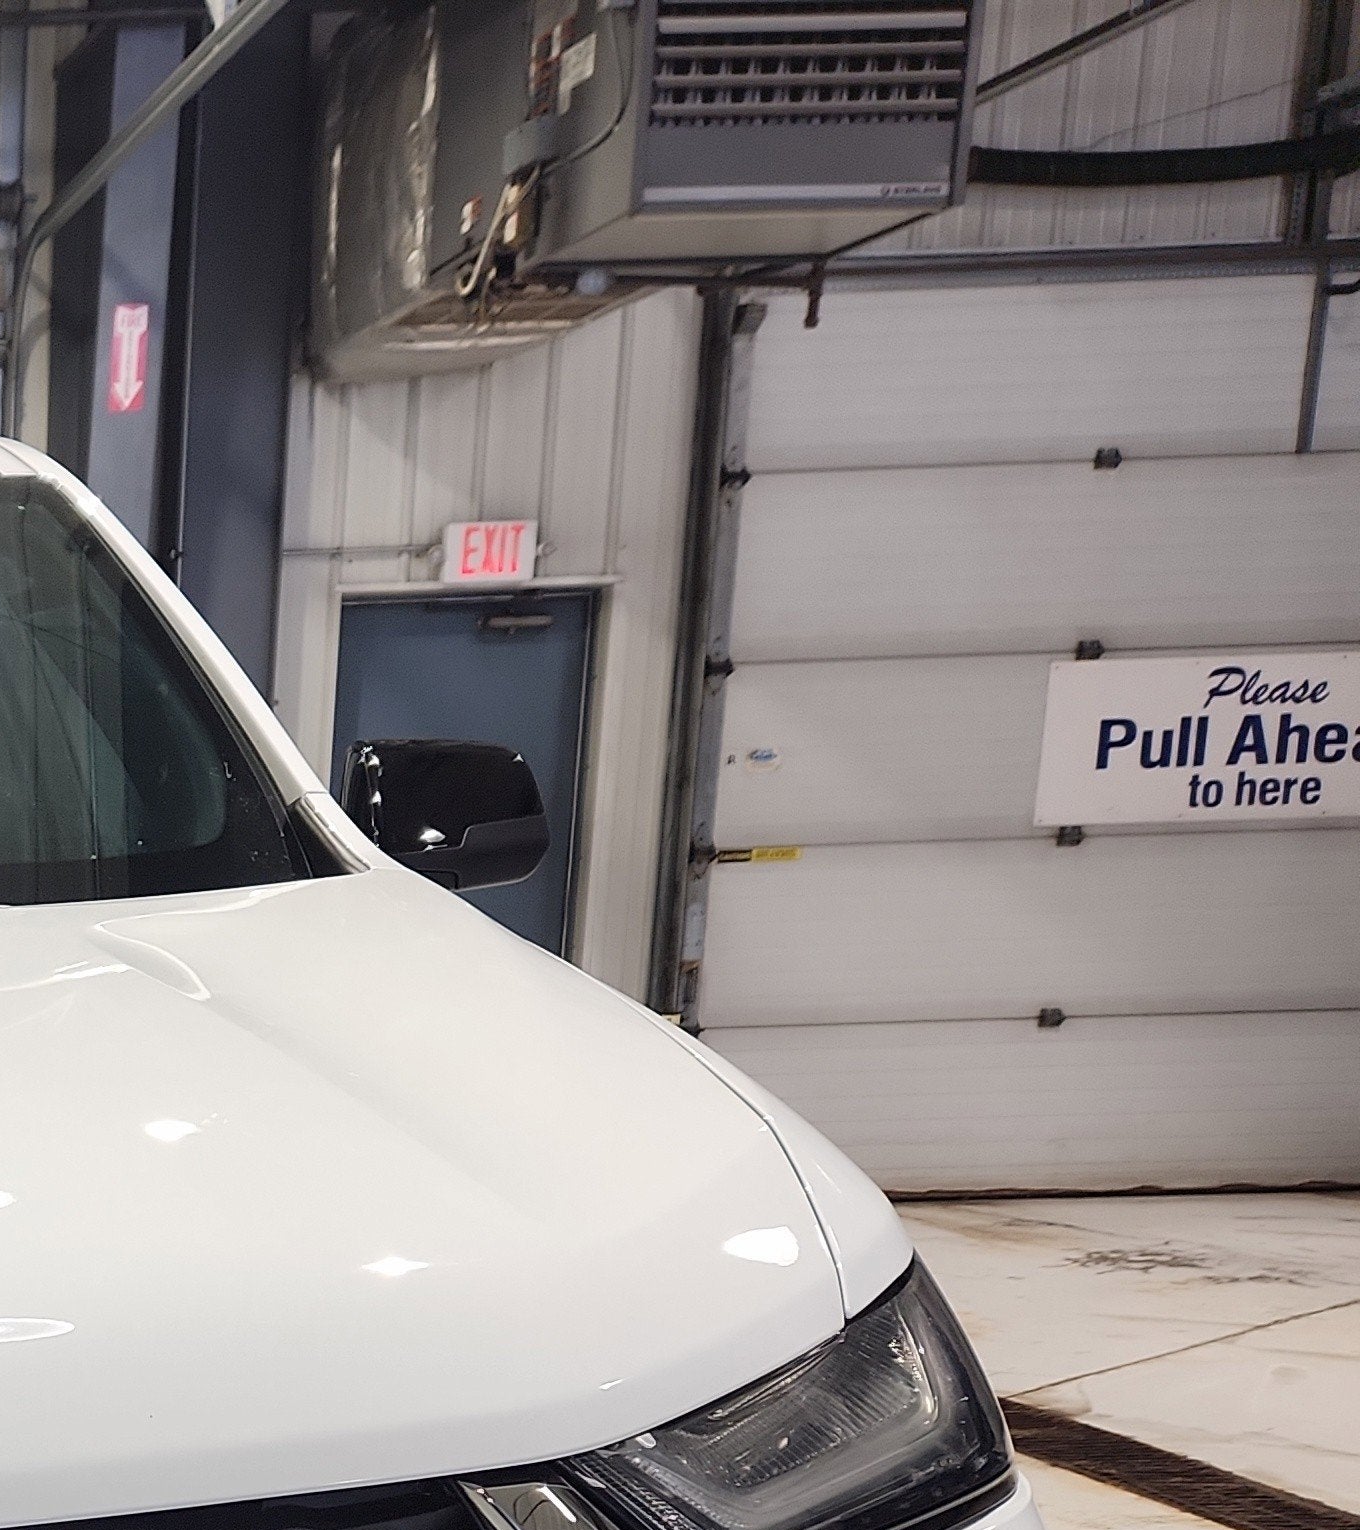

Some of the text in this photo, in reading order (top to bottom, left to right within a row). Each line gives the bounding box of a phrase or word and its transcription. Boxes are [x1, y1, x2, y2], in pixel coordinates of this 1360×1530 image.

[461, 523, 526, 574] EXIT
[1203, 665, 1331, 708] Please
[1095, 712, 1360, 770] Pull Ahe
[1188, 771, 1323, 808] to here
